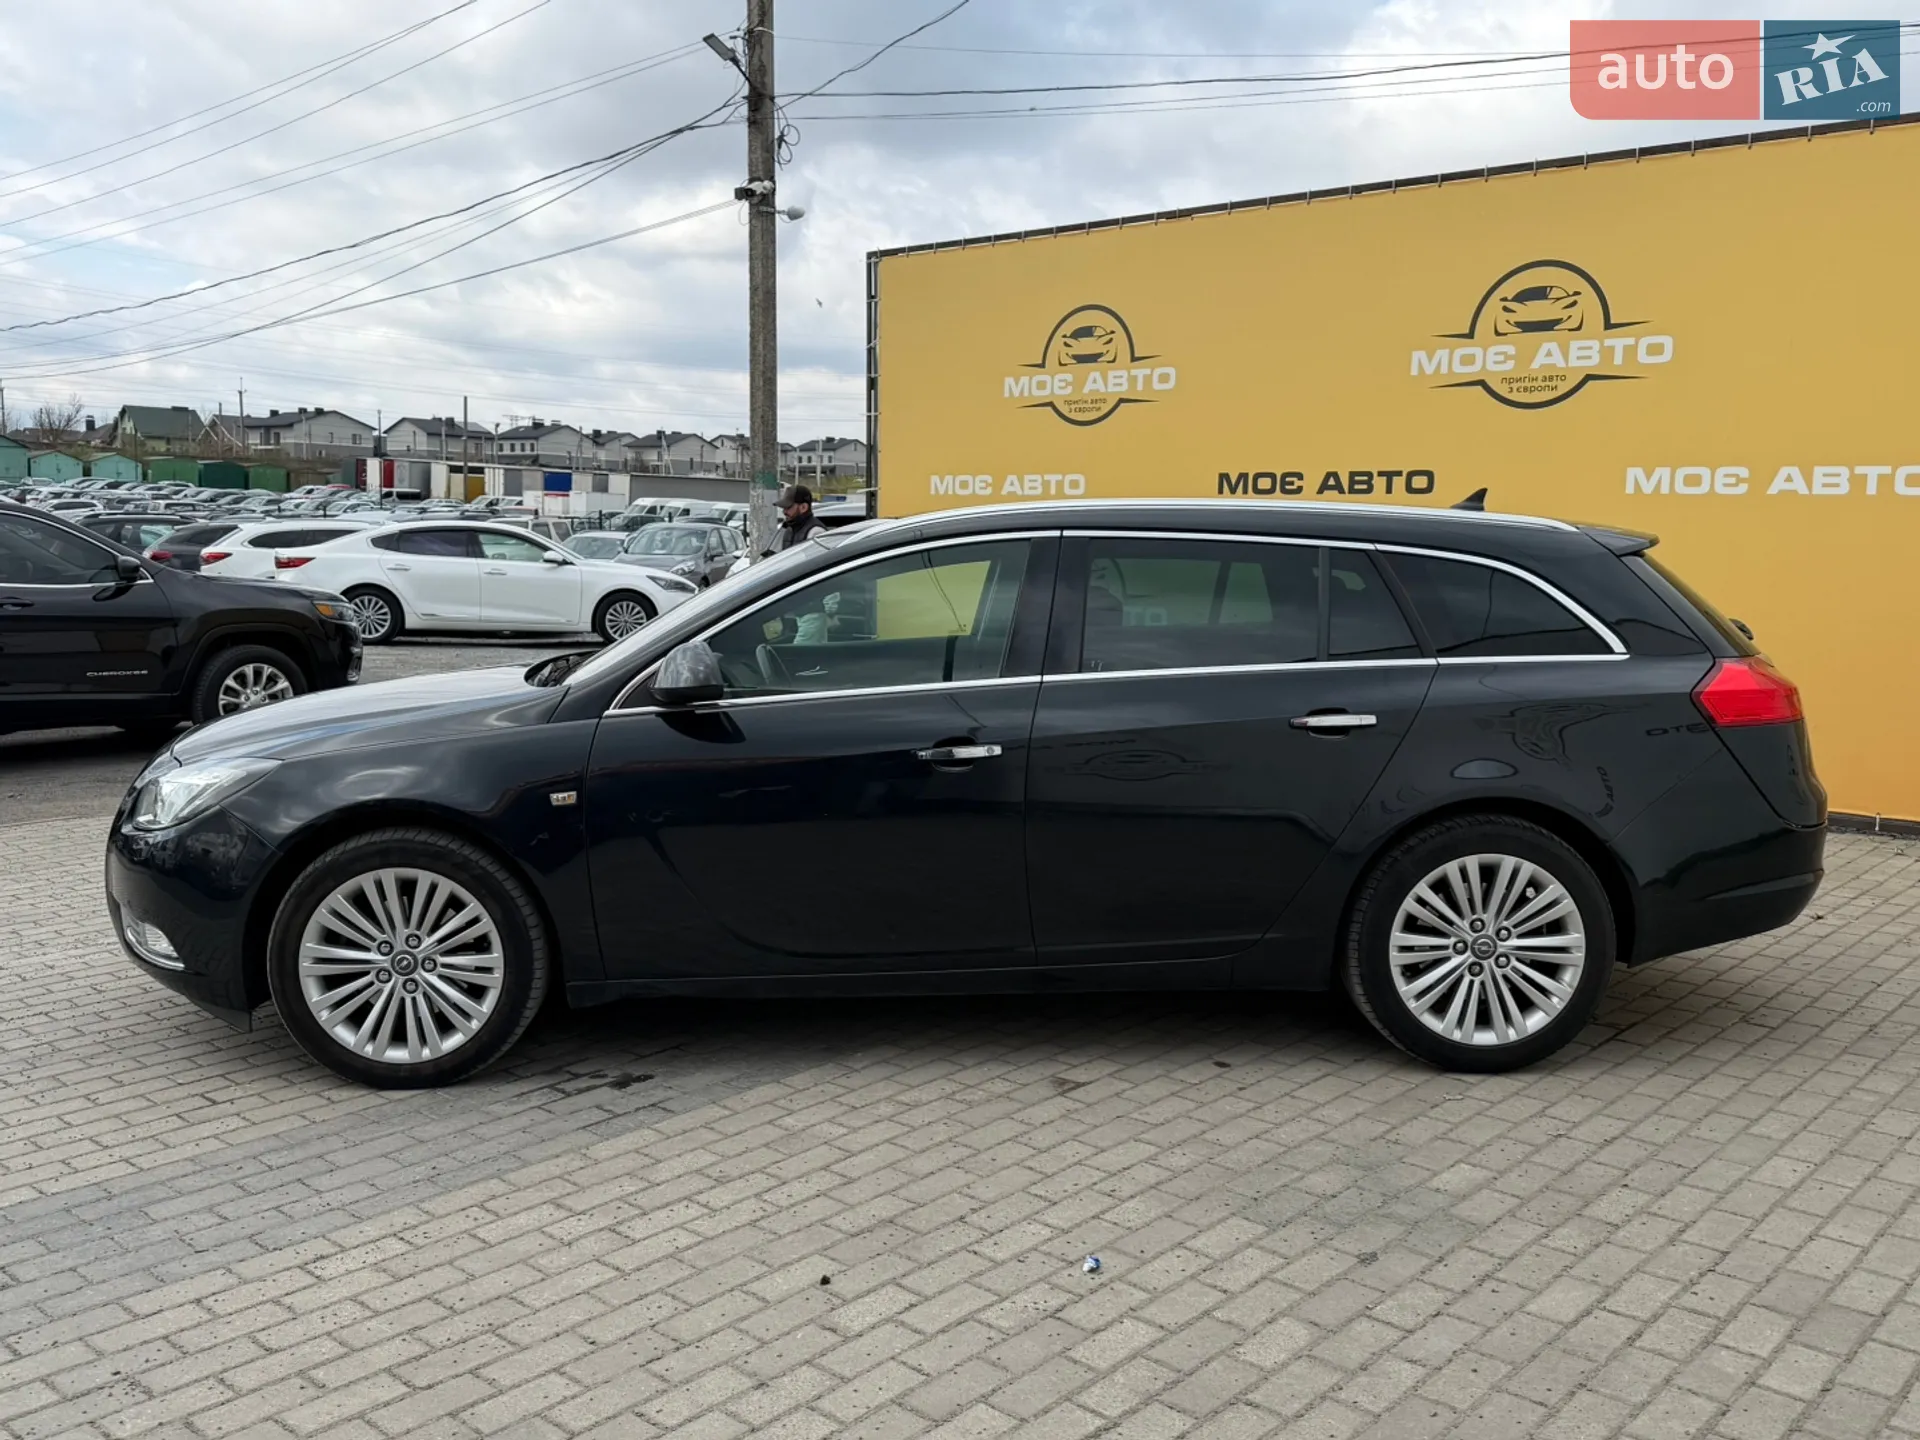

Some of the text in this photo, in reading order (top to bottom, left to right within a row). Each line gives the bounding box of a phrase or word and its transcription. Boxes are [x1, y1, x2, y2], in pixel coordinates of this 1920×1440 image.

[1411, 335, 1673, 376] МОЄ АВТО
[1004, 366, 1176, 398] МОЄ АВТО
[1500, 373, 1567, 385] пригін авто
[929, 474, 1086, 495] МОЄ АВТО
[1217, 469, 1435, 495] МОЄ АВТО
[1625, 466, 1920, 495] МОЄ АВТО
